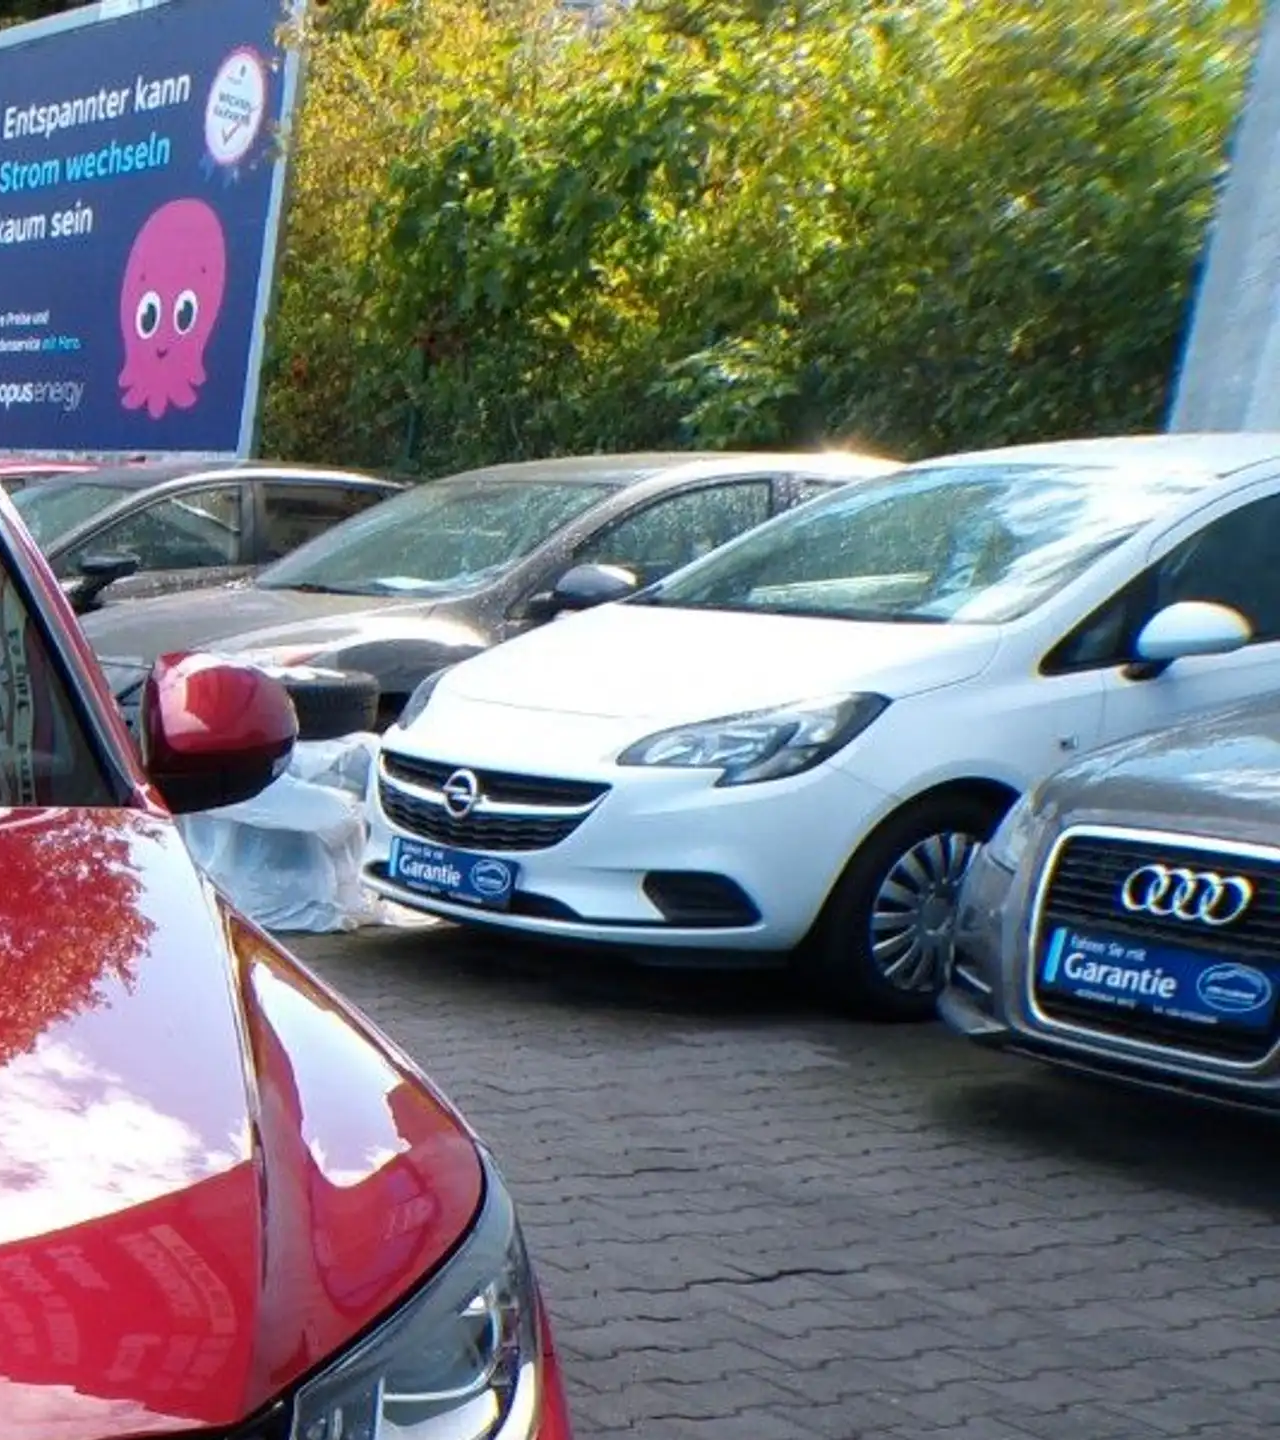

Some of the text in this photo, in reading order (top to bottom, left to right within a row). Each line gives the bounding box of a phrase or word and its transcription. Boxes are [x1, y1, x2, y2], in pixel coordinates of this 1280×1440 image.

[3, 74, 190, 140] Entspannter kann
[65, 131, 171, 181] wechseln
[50, 200, 93, 237] sein
[399, 853, 461, 887] Garantie
[1064, 952, 1177, 998] Garantie
